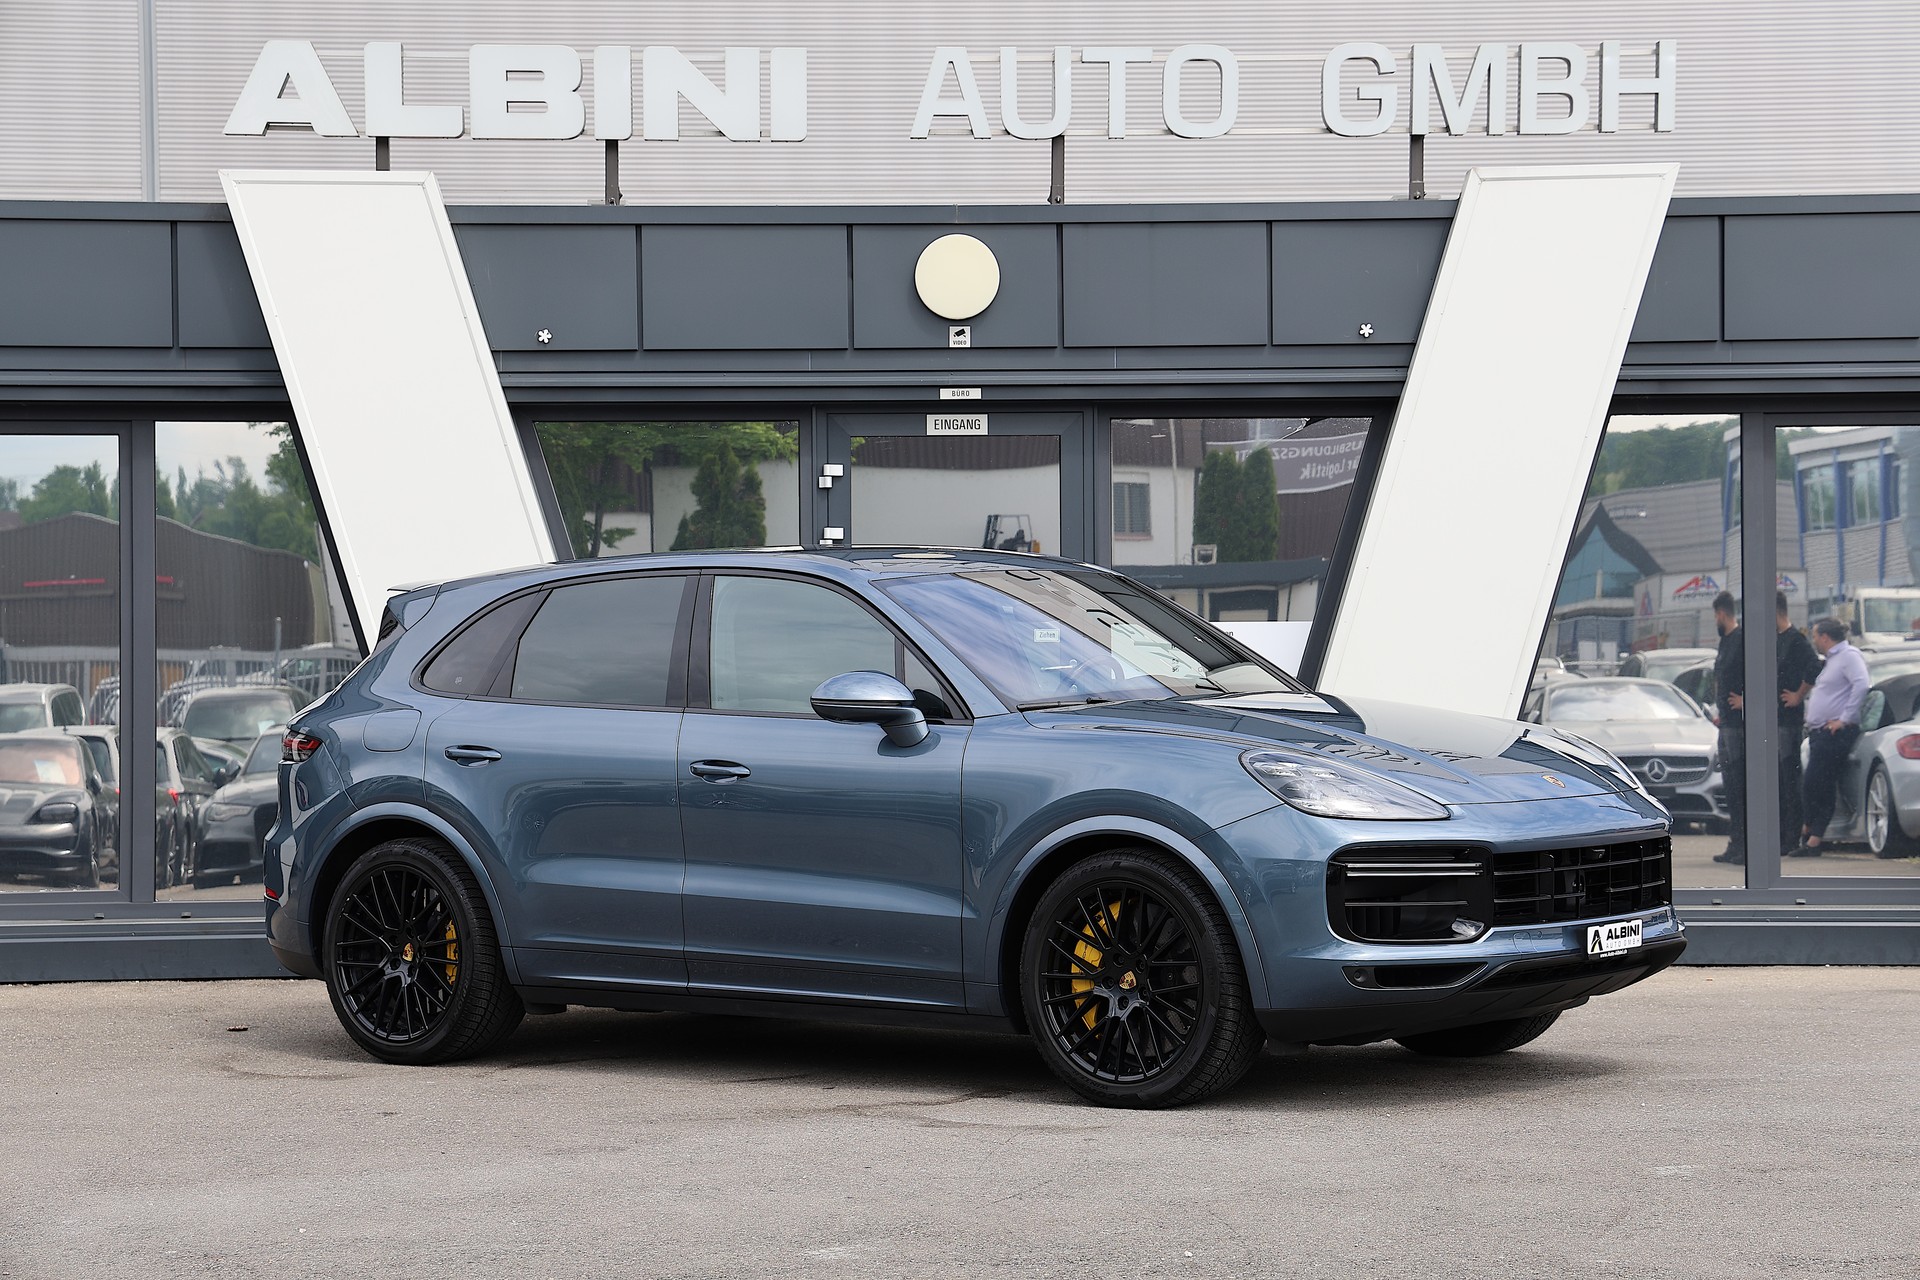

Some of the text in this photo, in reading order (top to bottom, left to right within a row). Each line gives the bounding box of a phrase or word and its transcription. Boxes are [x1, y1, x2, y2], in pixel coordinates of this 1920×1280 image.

[223, 39, 1677, 142] ALBINI AUTO GMBH
[934, 418, 981, 430] EINGANG
[1606, 924, 1640, 941] ALBINI
[1606, 941, 1621, 949] AUTO
